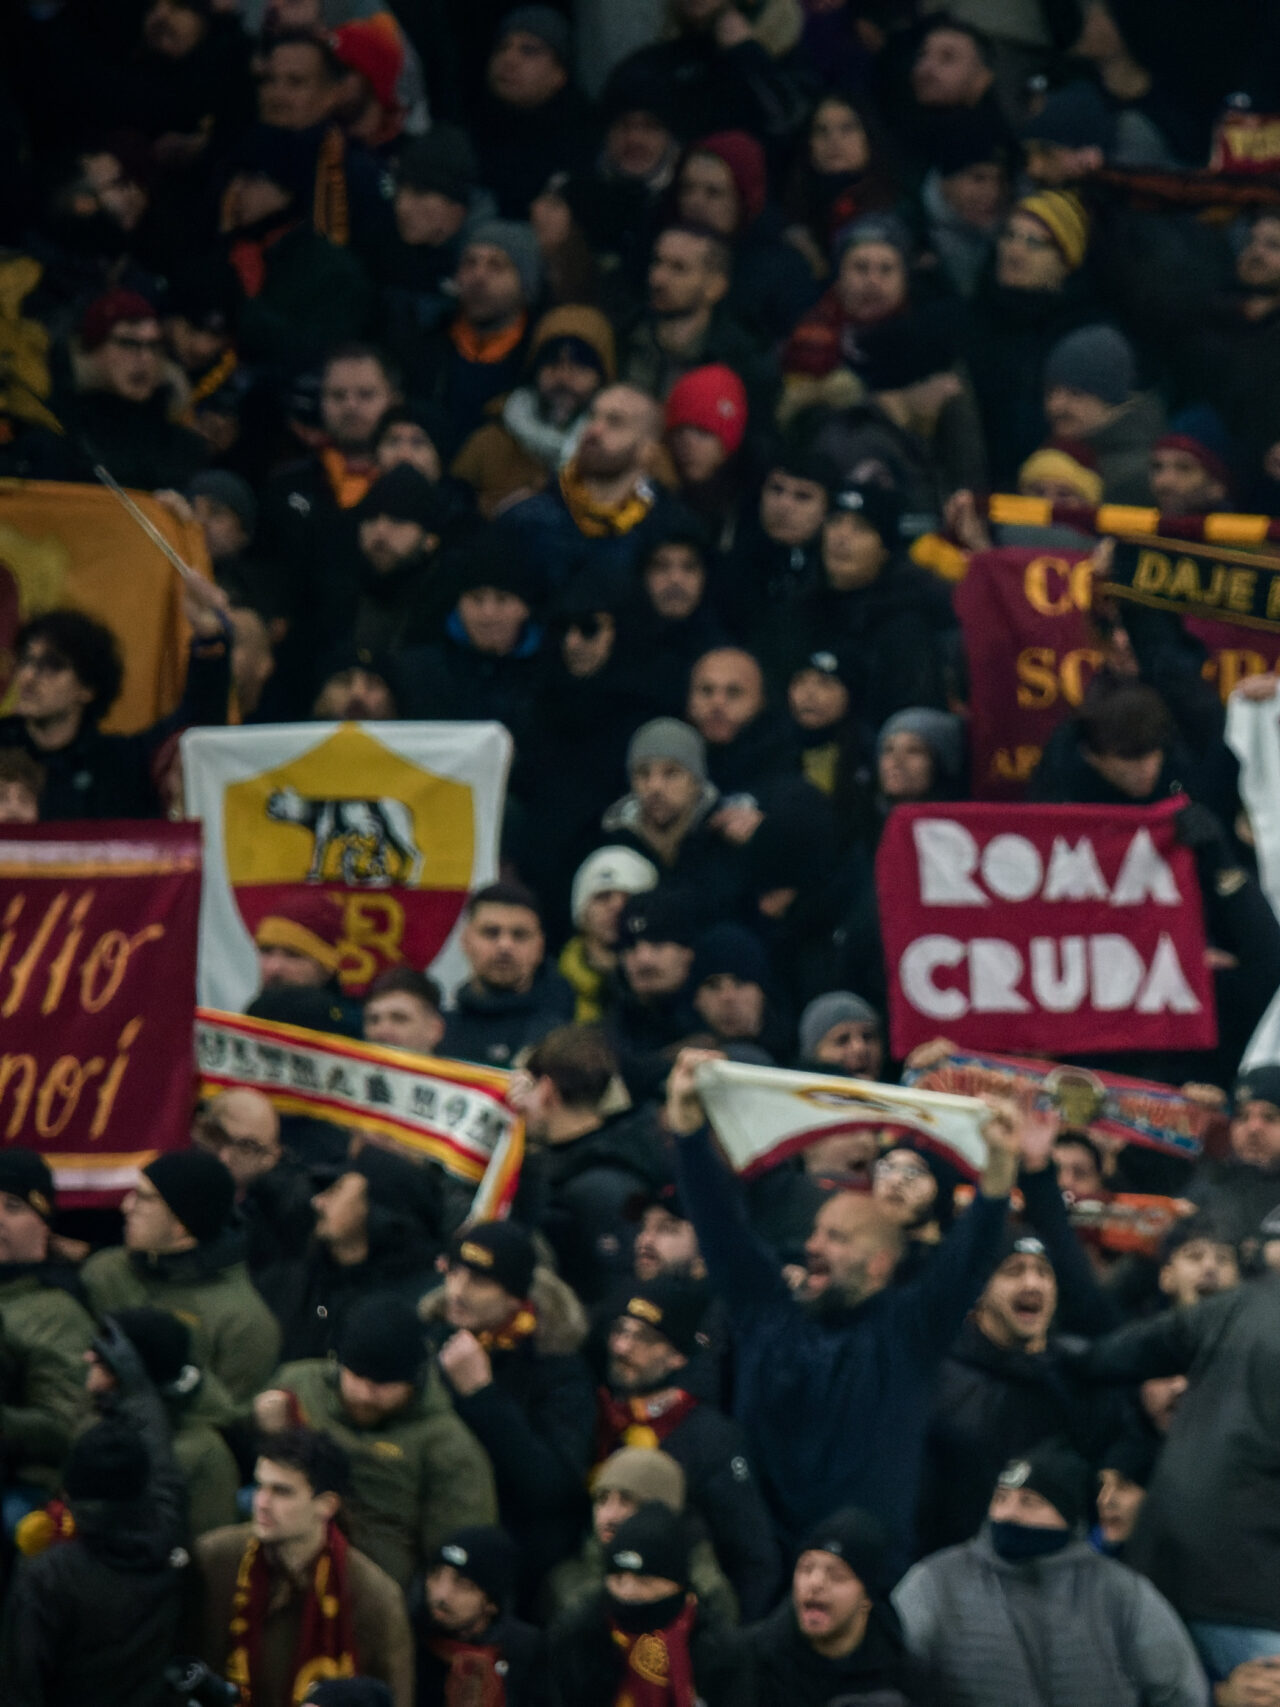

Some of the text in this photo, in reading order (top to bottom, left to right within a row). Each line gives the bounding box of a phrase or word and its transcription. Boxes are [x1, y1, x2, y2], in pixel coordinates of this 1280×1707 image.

[1131, 549, 1259, 614] DAJE
[911, 816, 1185, 909] ROMA
[898, 932, 1203, 1022] CRUDA
